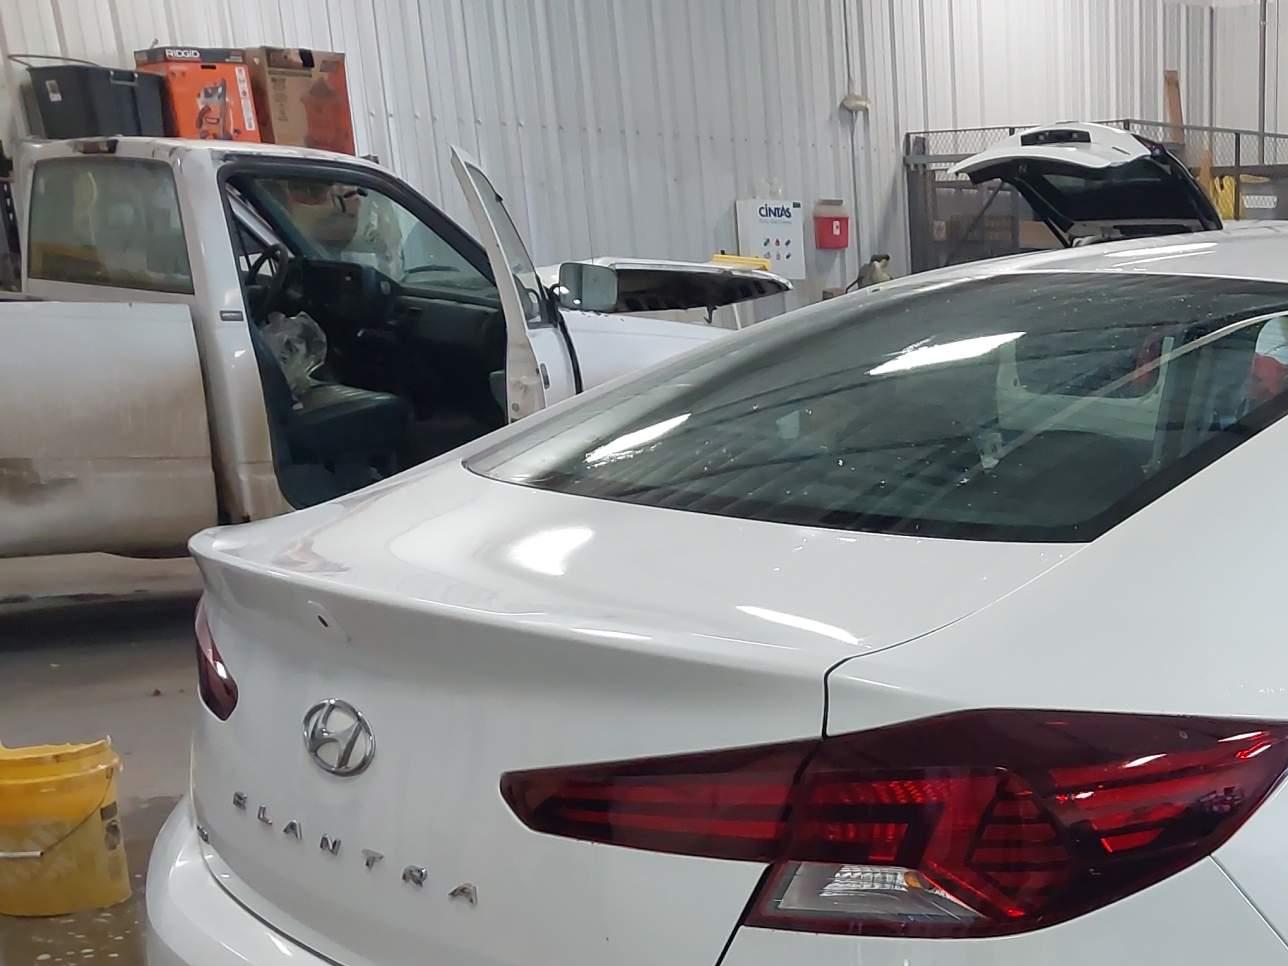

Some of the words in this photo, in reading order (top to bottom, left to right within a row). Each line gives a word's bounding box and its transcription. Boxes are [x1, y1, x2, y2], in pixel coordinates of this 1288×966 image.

[165, 48, 200, 59] RIDGID
[758, 203, 792, 219] CINTAS
[232, 790, 479, 907] ELANTRA
